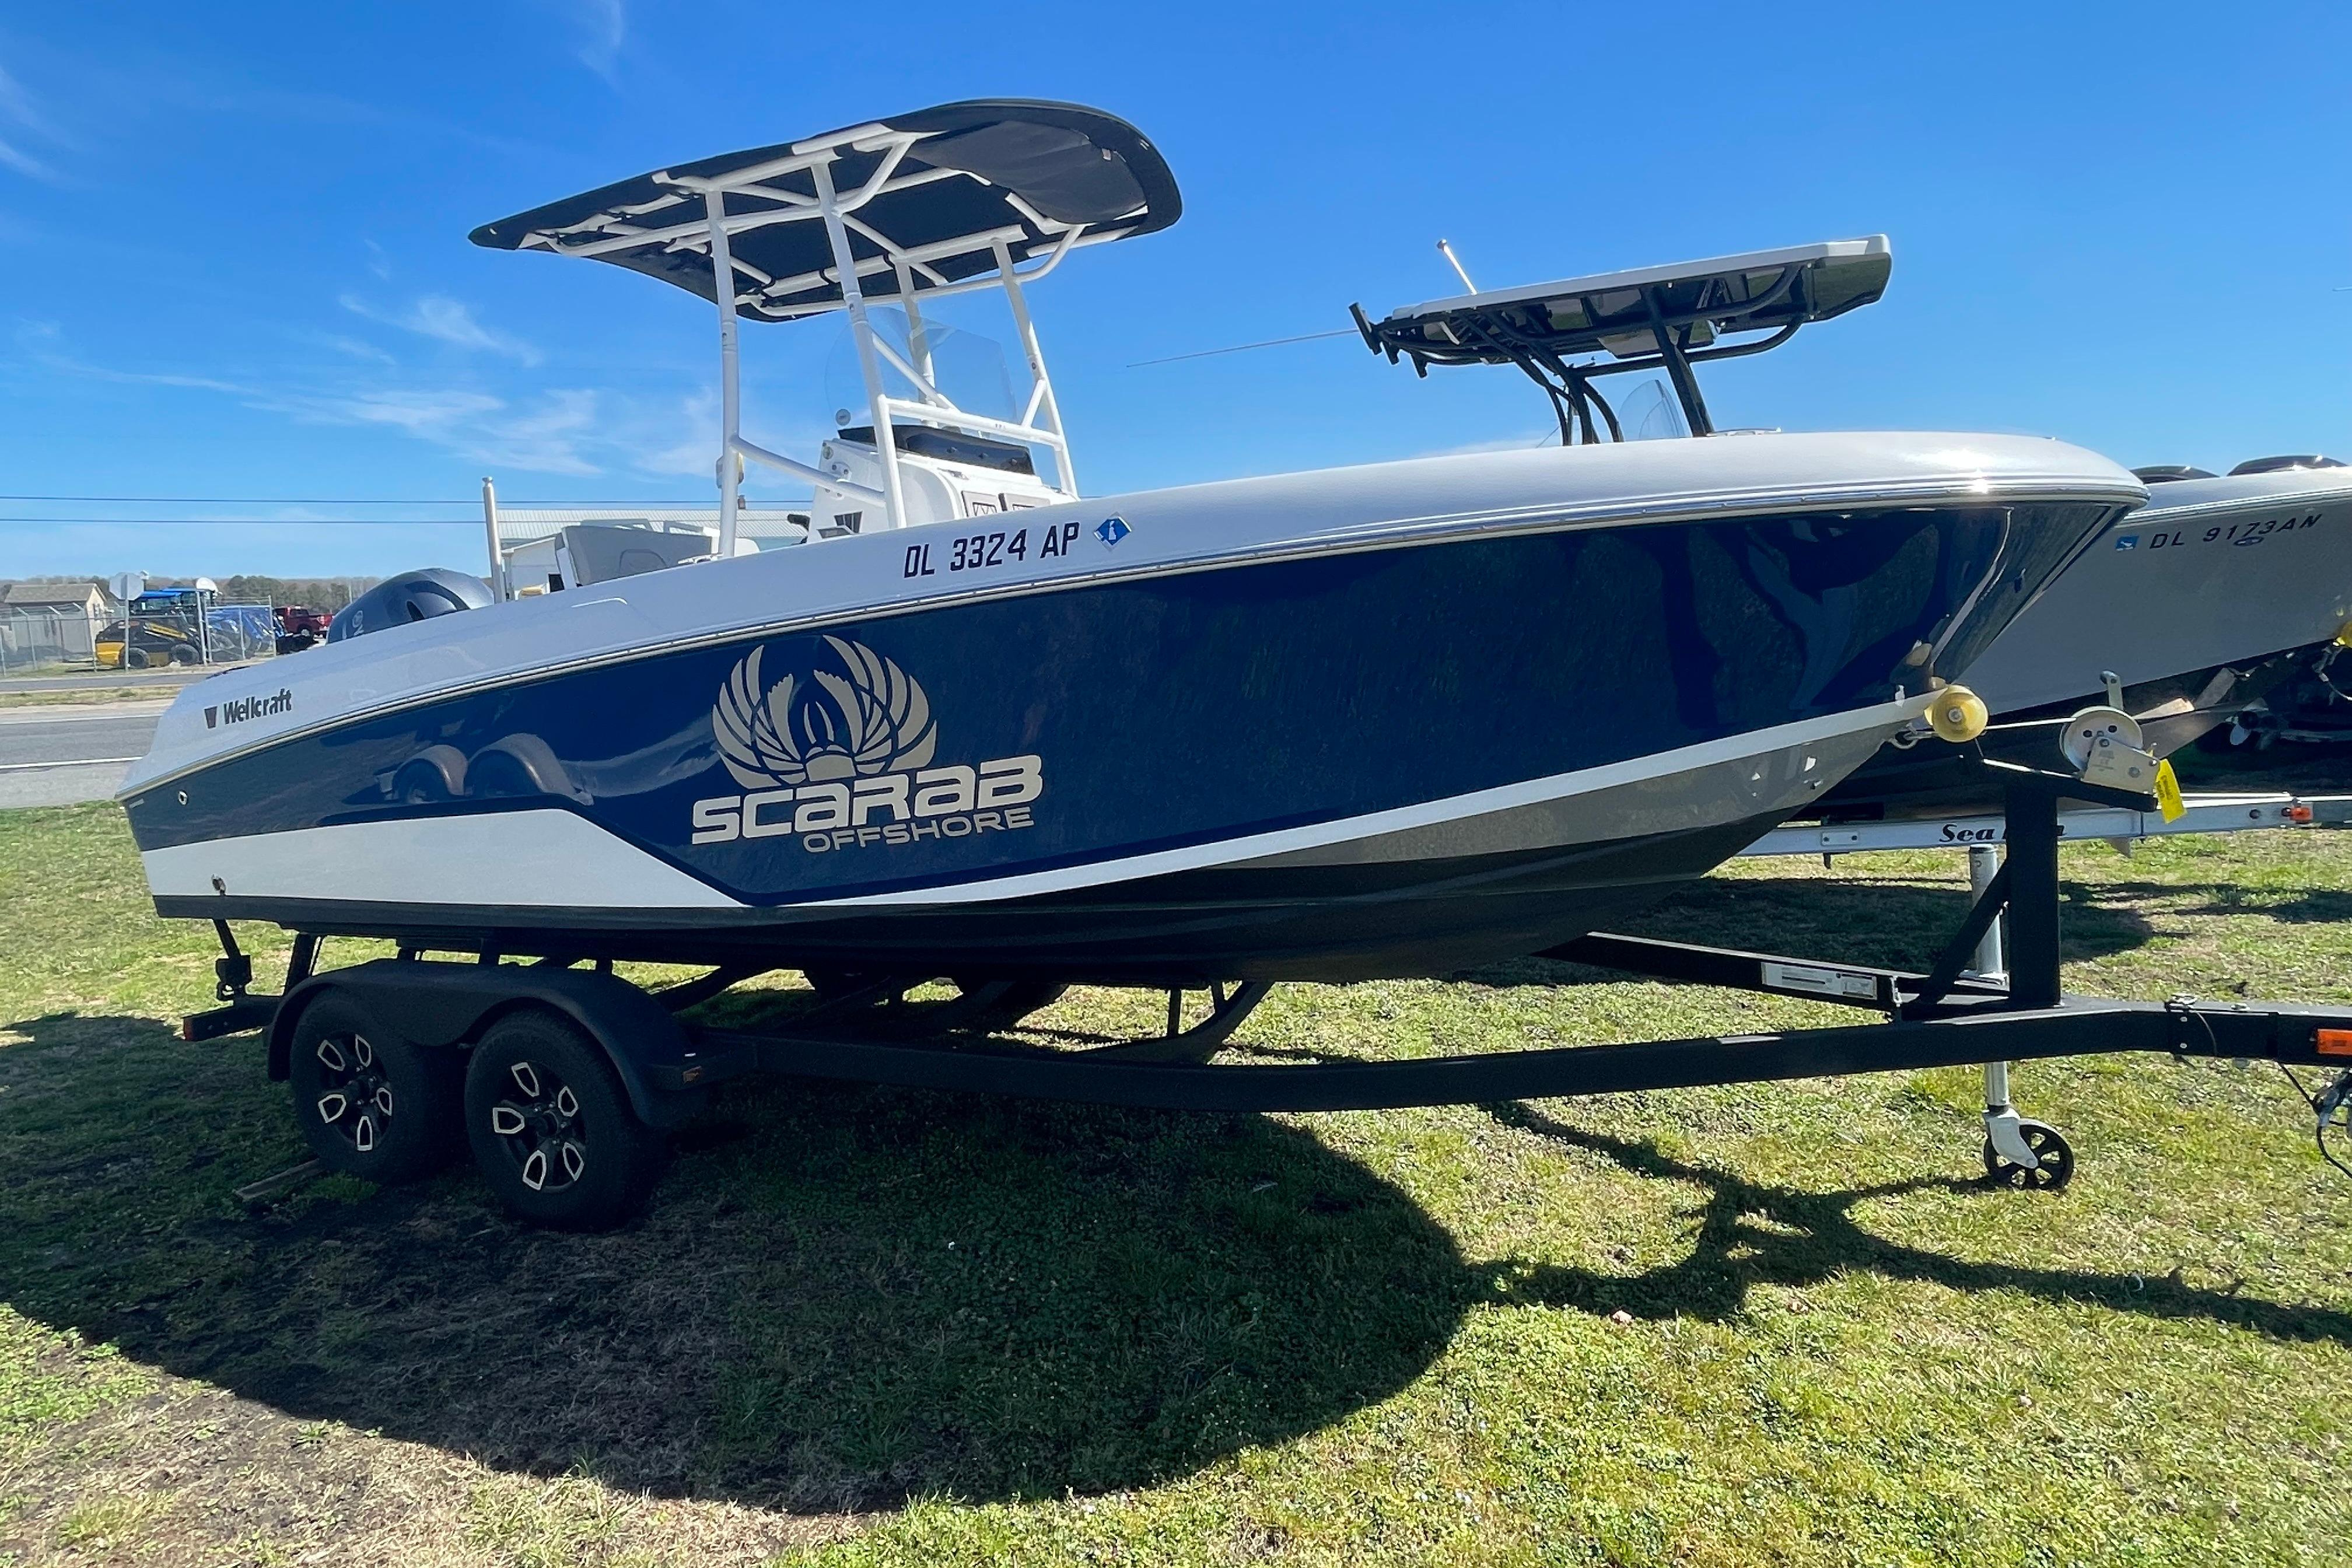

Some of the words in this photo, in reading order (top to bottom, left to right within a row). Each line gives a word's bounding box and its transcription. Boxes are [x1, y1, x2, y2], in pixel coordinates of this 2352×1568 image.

[904, 544, 935, 578] DL
[950, 528, 1027, 571] 3324
[1040, 522, 1080, 559] AP
[2149, 531, 2185, 549] DL
[224, 688, 292, 724] Wellcraft
[803, 807, 1034, 853] OFFSHORE
[1939, 823, 1995, 842] Sea
